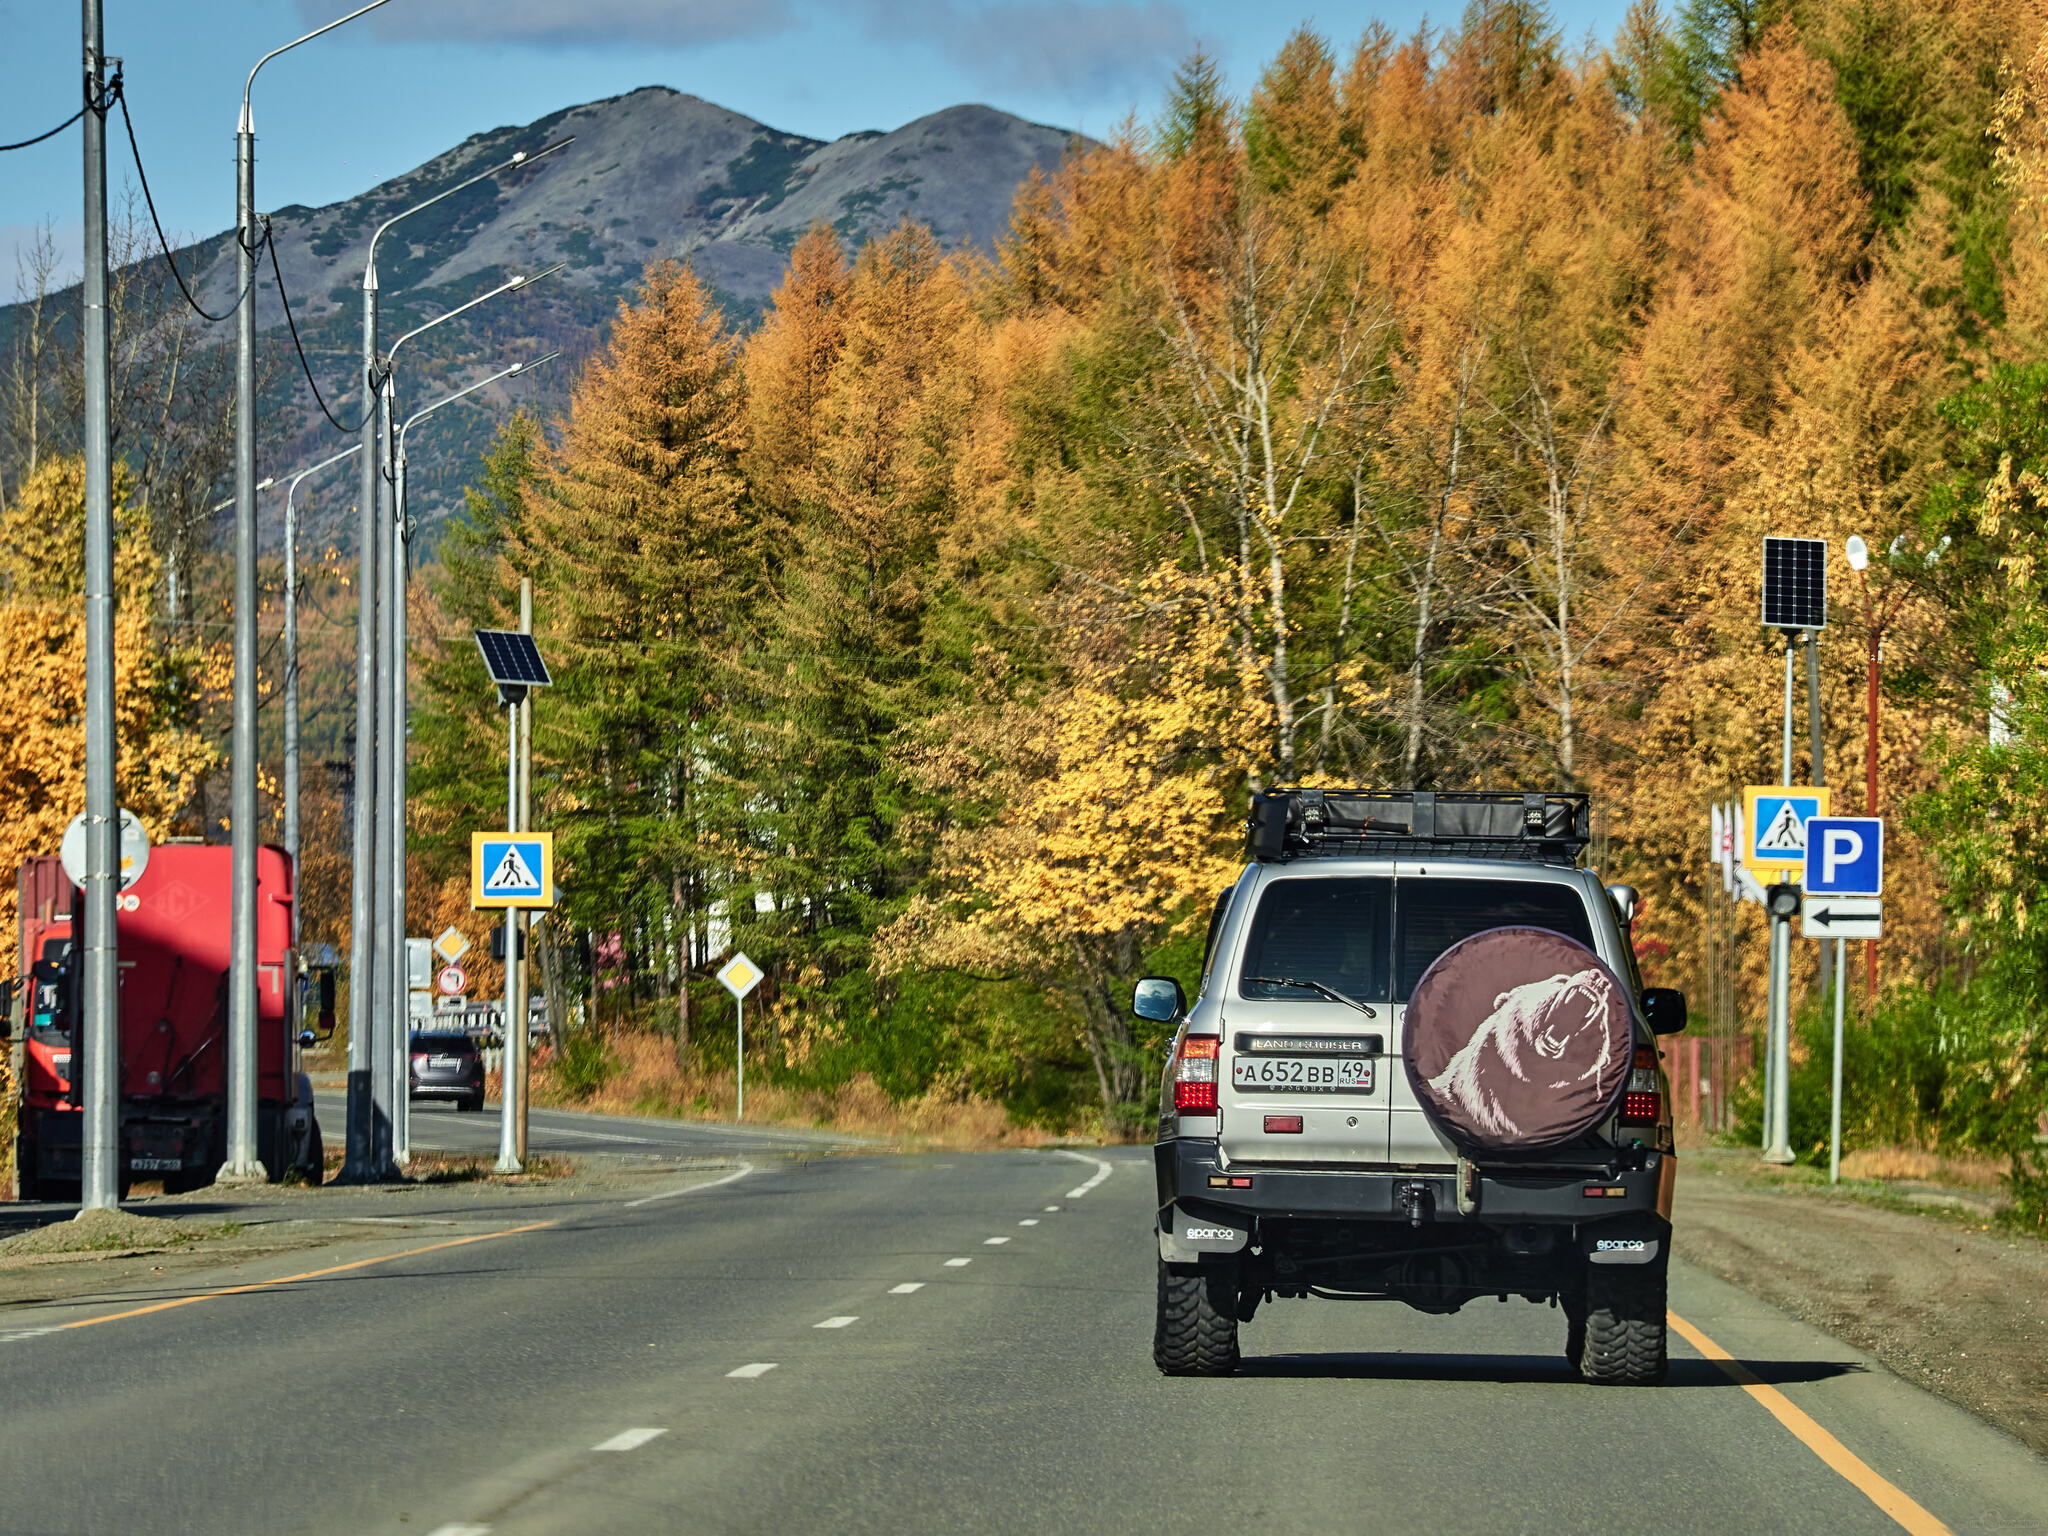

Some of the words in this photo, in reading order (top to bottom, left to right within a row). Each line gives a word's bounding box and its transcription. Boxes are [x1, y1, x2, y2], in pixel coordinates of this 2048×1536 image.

[1822, 829, 1864, 884] P
[1256, 1040, 1293, 1049] LAND
[1299, 1041, 1362, 1050] CRUISER
[1341, 1061, 1364, 1078] 49
